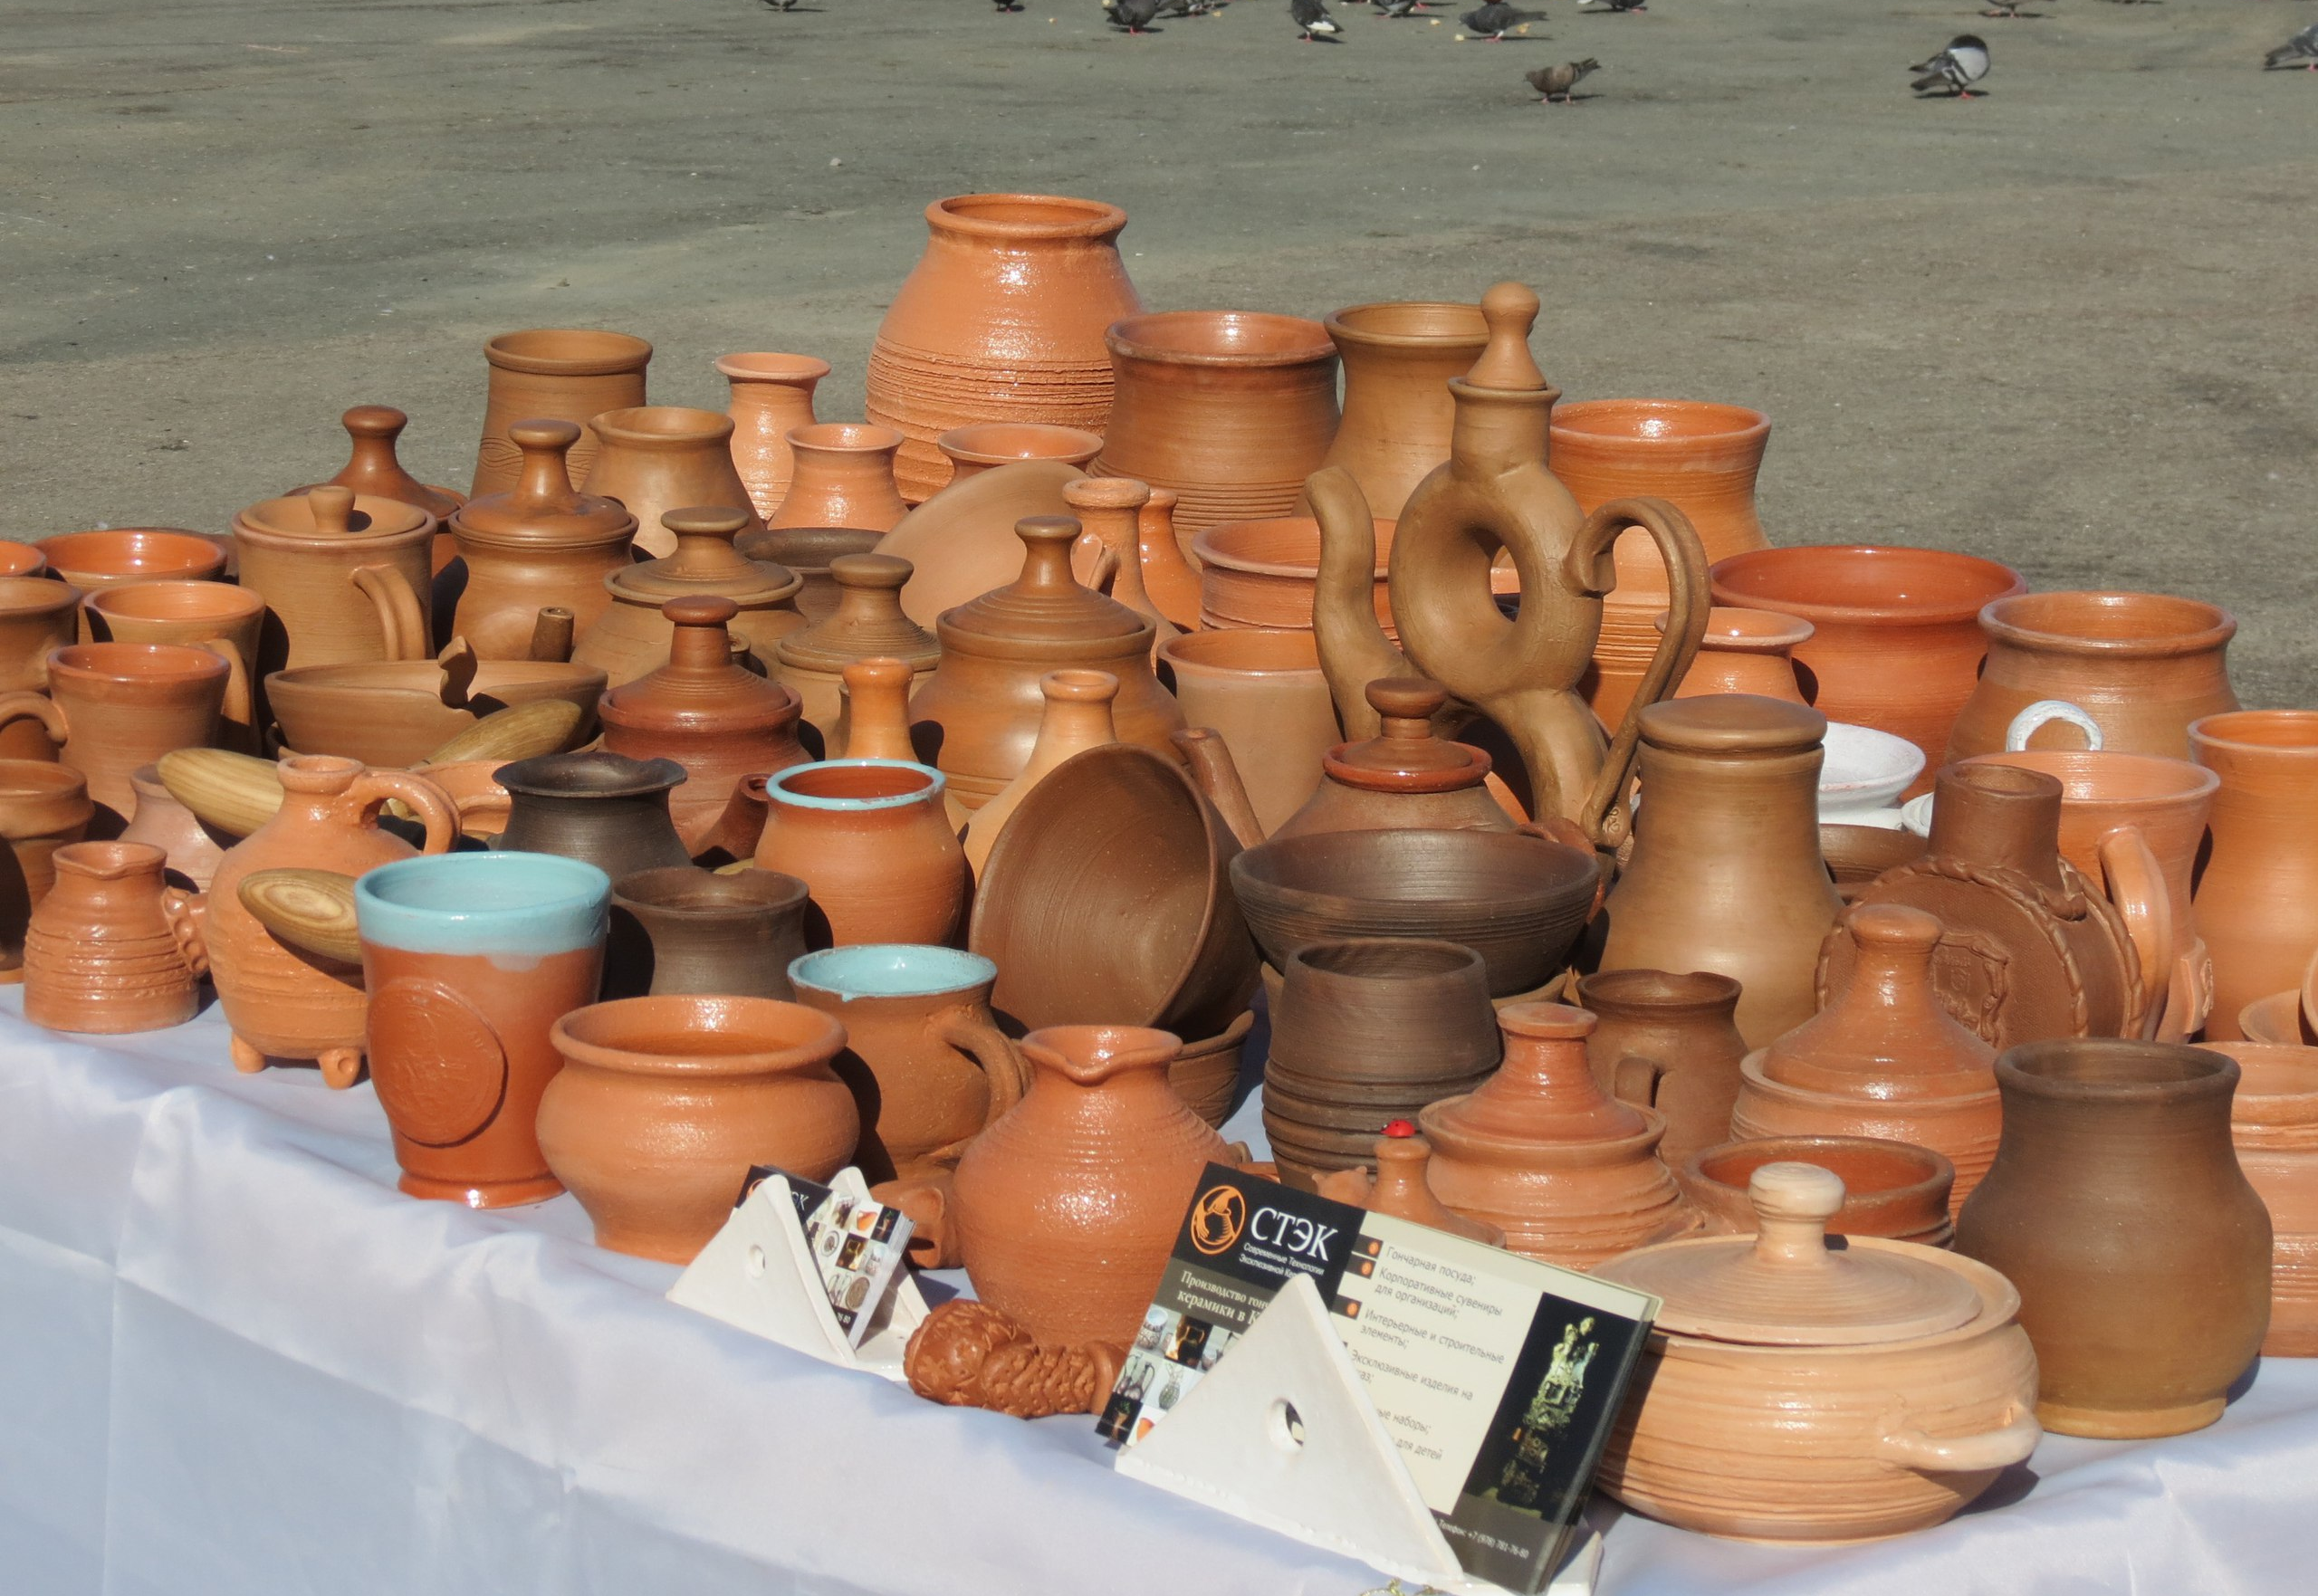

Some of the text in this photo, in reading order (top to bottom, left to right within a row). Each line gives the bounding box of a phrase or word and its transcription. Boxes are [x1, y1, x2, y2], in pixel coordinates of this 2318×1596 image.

[1251, 1208, 1338, 1261] СТЭК
[1243, 1242, 1325, 1276] Современные Технологии
[1385, 1246, 1477, 1286] Гончарная посуда;
[1181, 1270, 1247, 1303] Производство
[1375, 1283, 1460, 1320] для организаций;
[1379, 1266, 1503, 1316] Корпоративные сувениры
[1177, 1290, 1236, 1319] керамики
[1237, 1310, 1246, 1322] в
[1360, 1324, 1410, 1350] элементы;
[1365, 1307, 1505, 1364] Интерьерные и строительные
[1352, 1349, 1473, 1401] Эксклюзивные изделия на
[1393, 1413, 1432, 1435] наборы;
[1395, 1438, 1443, 1461] для детей
